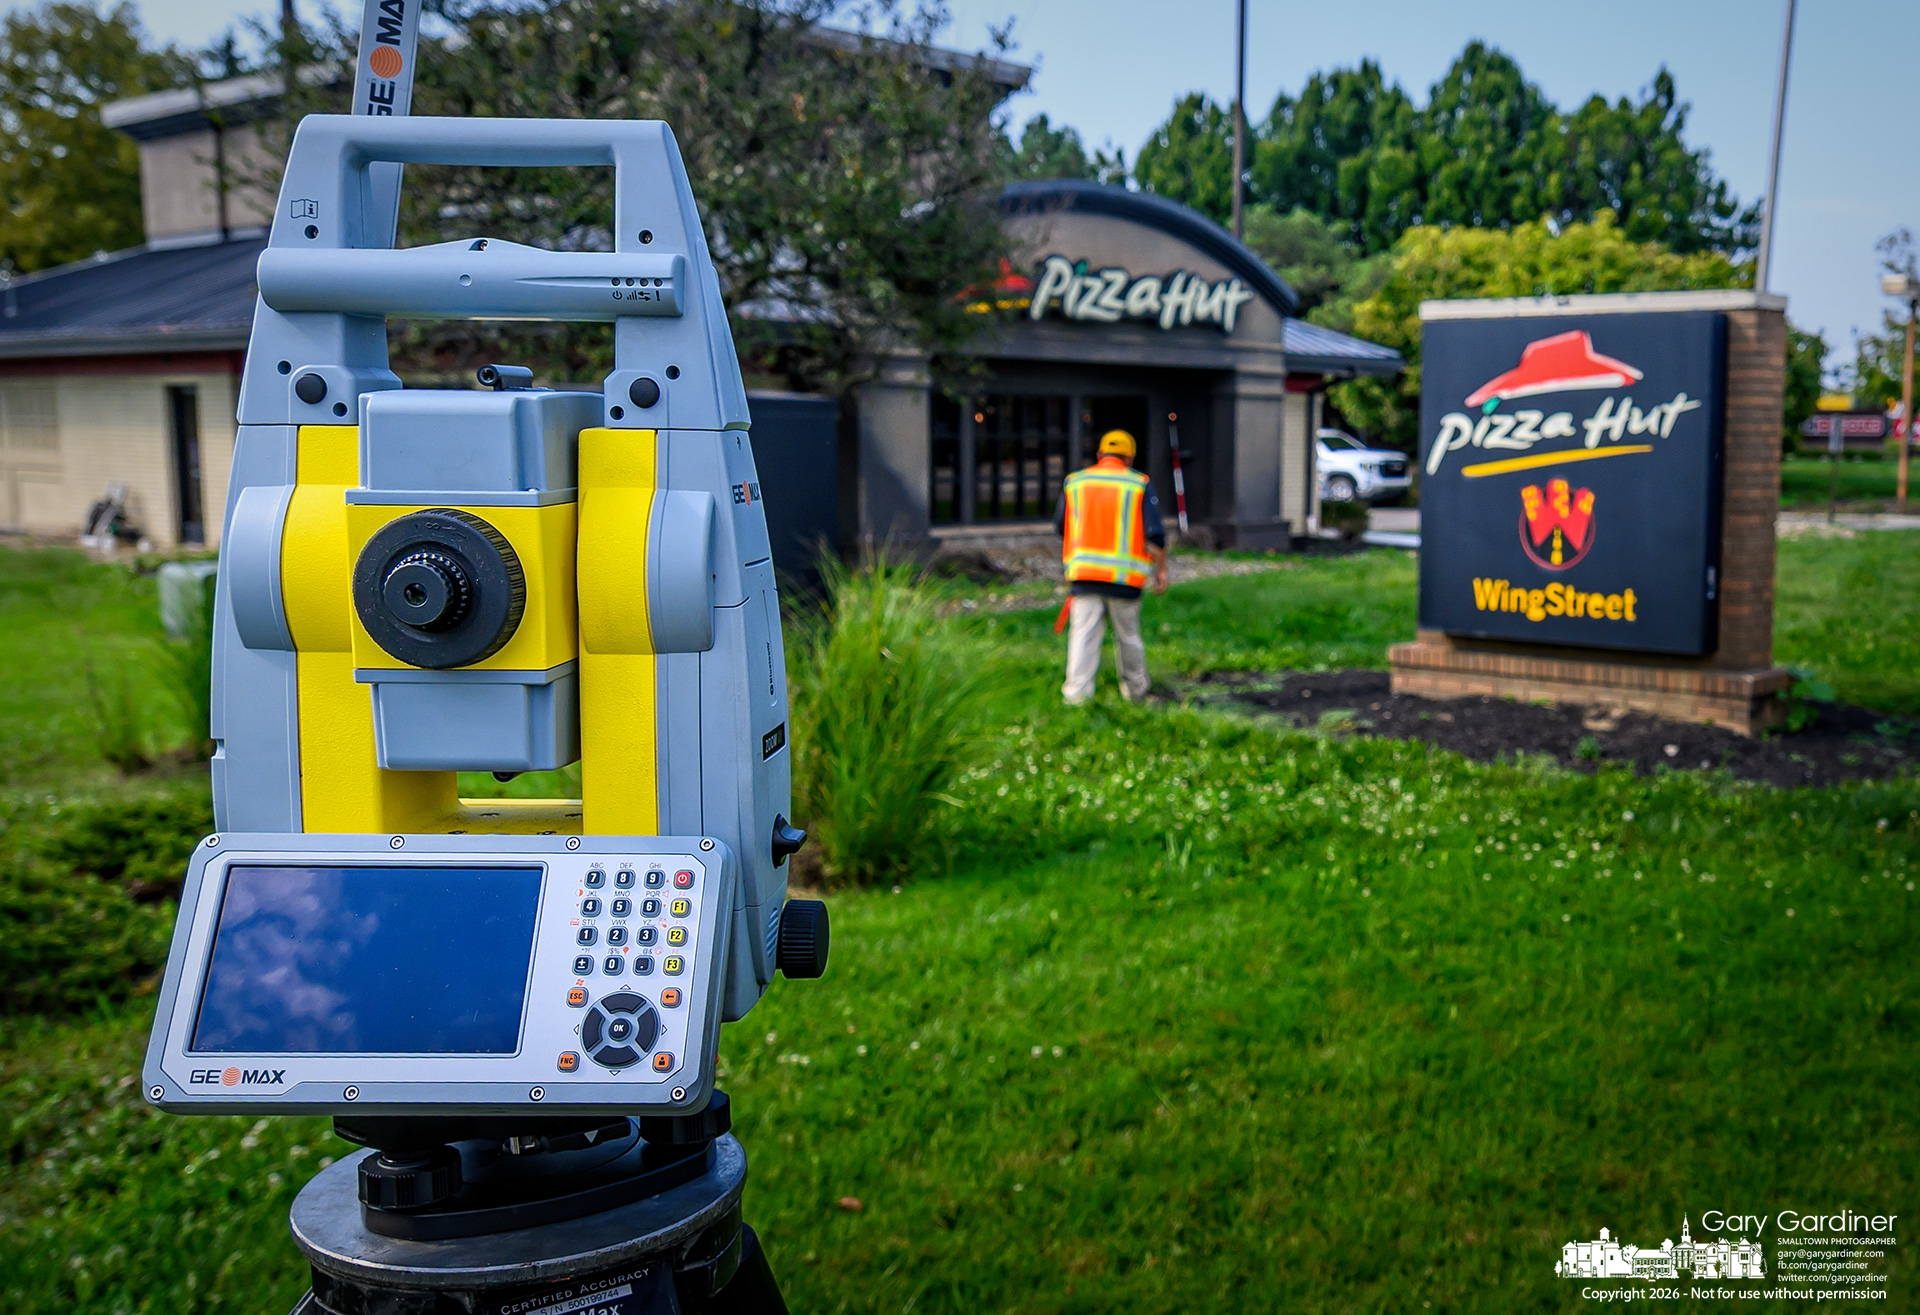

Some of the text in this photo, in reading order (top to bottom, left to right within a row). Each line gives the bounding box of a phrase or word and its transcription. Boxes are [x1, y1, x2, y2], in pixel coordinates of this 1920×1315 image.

[1029, 255, 1255, 332] Pizza Hut
[1581, 391, 1702, 450] Hut
[1473, 577, 1637, 622] WingStreet
[590, 873, 597, 883] 7
[620, 873, 626, 883] 8
[650, 873, 656, 883] 9
[586, 901, 593, 911] 4
[616, 901, 623, 911] 5
[646, 902, 653, 911] 6
[674, 902, 684, 911] F1
[584, 930, 589, 940] 1
[612, 930, 619, 940] 2
[642, 930, 649, 940] 3
[670, 930, 681, 940] F2
[608, 959, 615, 969] 0
[667, 960, 678, 969] F3
[570, 992, 583, 1000] ESC
[613, 1024, 624, 1032] OK
[500, 1267, 650, 1315] CERTIFIED ACCURACY
[568, 1288, 619, 1310] 500199744
